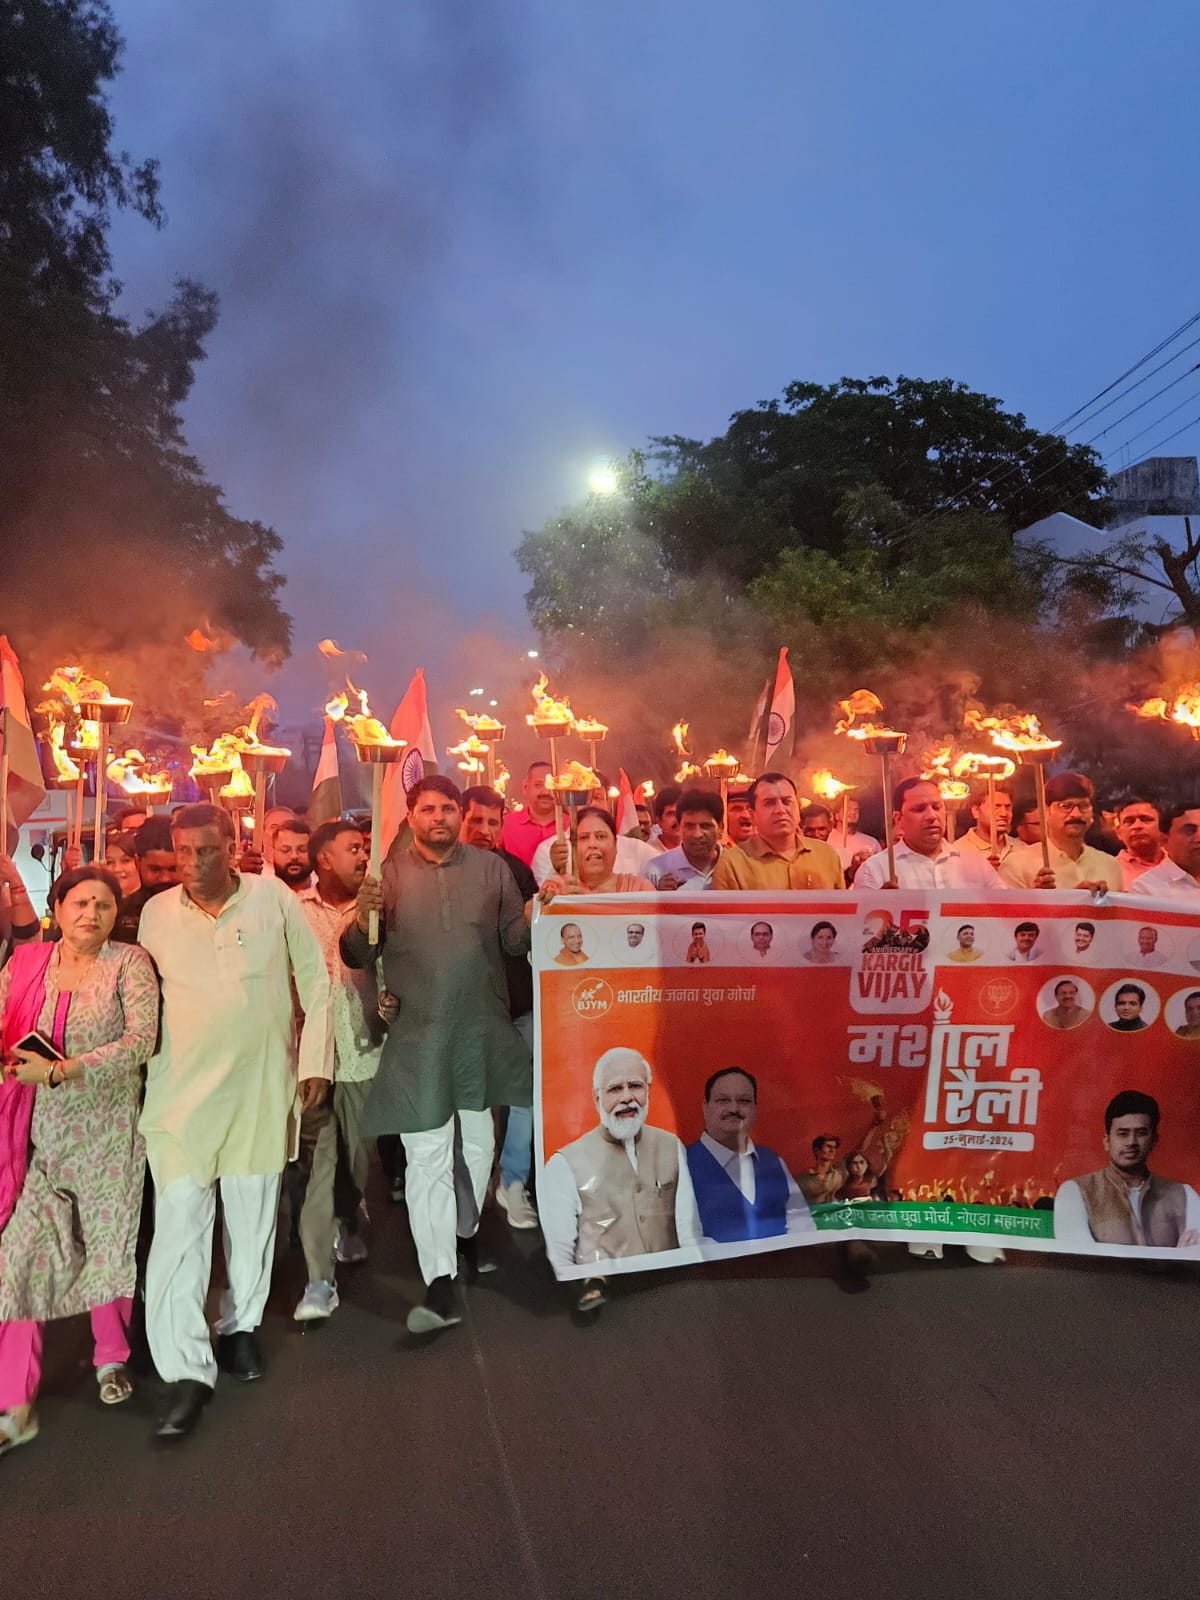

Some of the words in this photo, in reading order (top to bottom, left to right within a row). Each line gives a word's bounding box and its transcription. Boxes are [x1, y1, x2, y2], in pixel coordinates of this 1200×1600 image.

[863, 909, 930, 953] 25
[862, 954, 926, 972] KARGIL
[617, 986, 662, 1004] भारतीय
[665, 989, 700, 1002] जनता
[702, 989, 725, 1006] युवा
[727, 984, 757, 1001] मोर्चा
[858, 972, 928, 1003] VIJAY
[577, 1000, 607, 1011] BJYM
[944, 1068, 1043, 1125] रैली
[943, 1134, 1014, 1146] 25-जुलाई-2024
[867, 1210, 898, 1223] जनता
[900, 1210, 921, 1227] युवा
[923, 1206, 954, 1226] मोर्चा,
[957, 1207, 991, 1226] नोएडा
[994, 1214, 1042, 1230] महानगर
